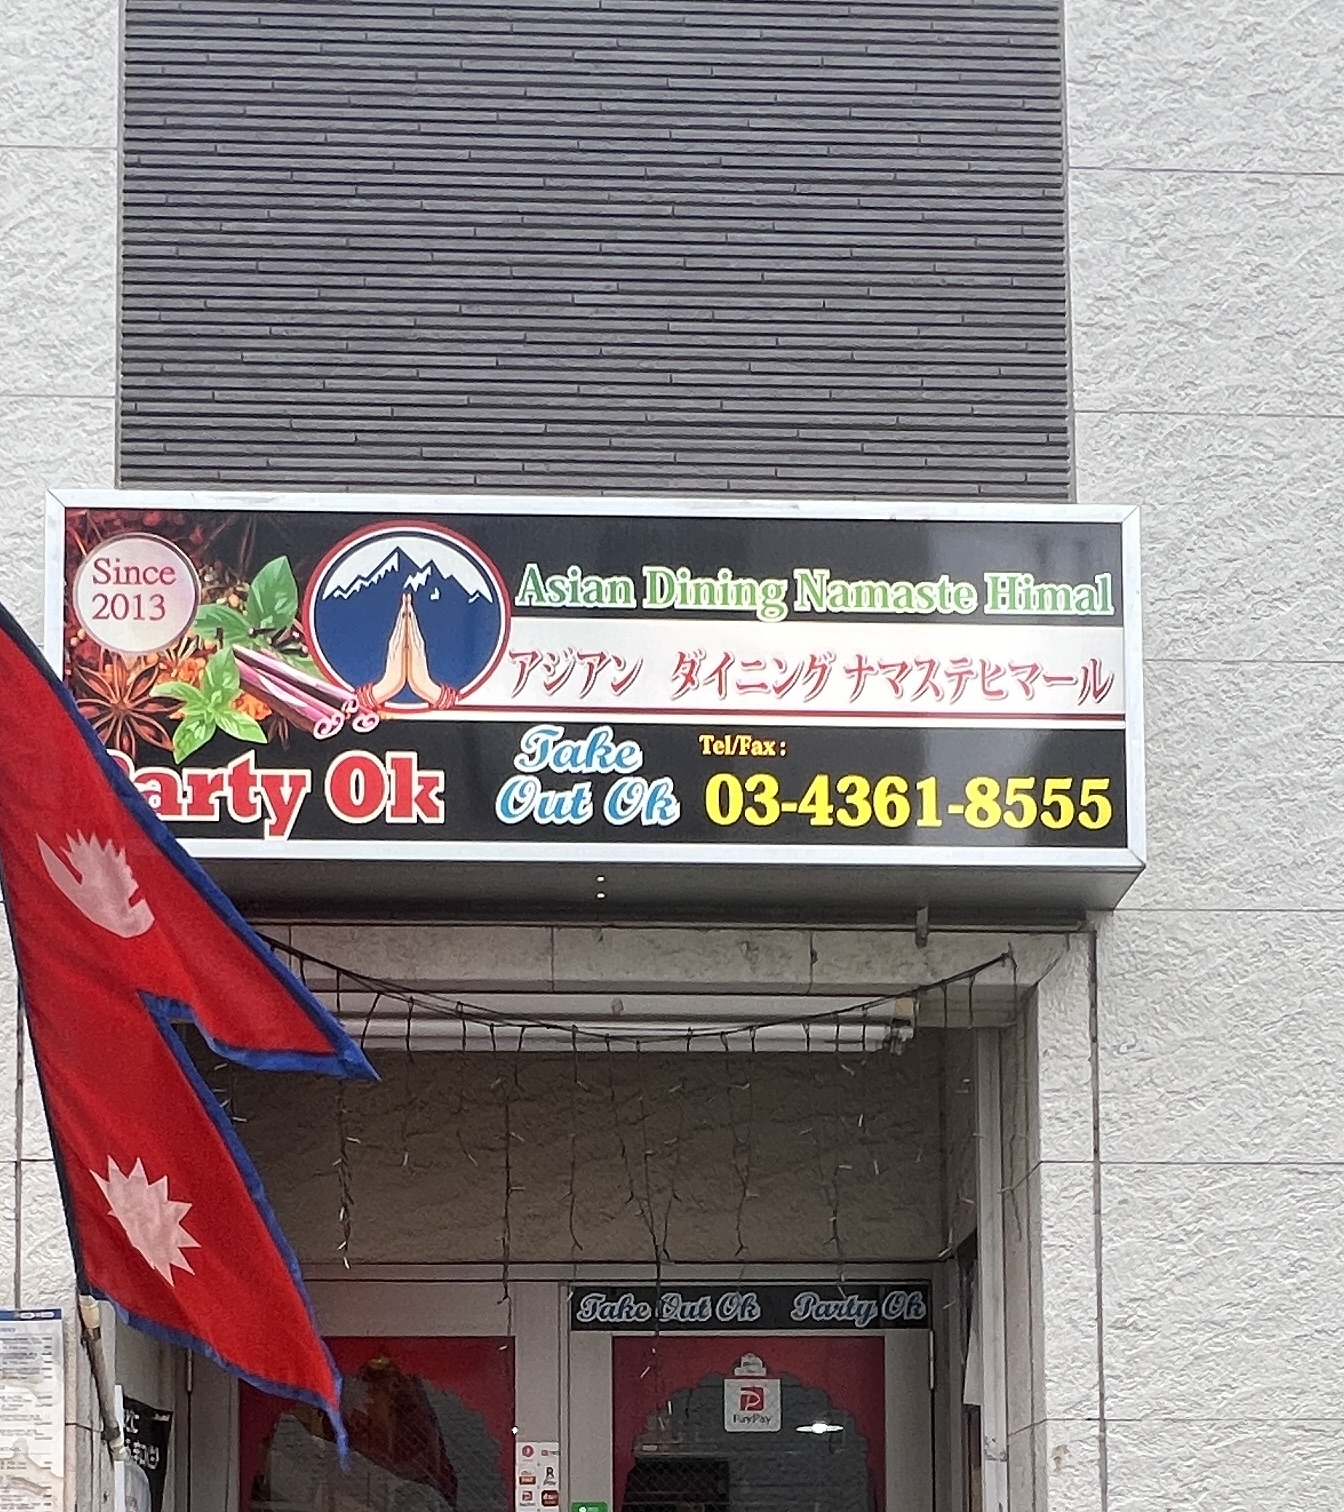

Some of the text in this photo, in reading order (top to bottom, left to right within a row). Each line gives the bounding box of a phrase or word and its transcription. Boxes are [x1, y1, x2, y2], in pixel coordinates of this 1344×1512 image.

[92, 557, 176, 586] Since
[516, 563, 1115, 623] Asian Dining Namaste Himal
[92, 593, 166, 621] 2013
[508, 647, 644, 699] アジアン
[671, 648, 836, 702] ダイニング
[515, 727, 643, 775] Take
[106, 749, 445, 840] arty Ok
[495, 776, 681, 827] Out Ok
[705, 774, 1112, 830] 03-4361-8555
[576, 1290, 927, 1327] Take Out Ok Party Ok
